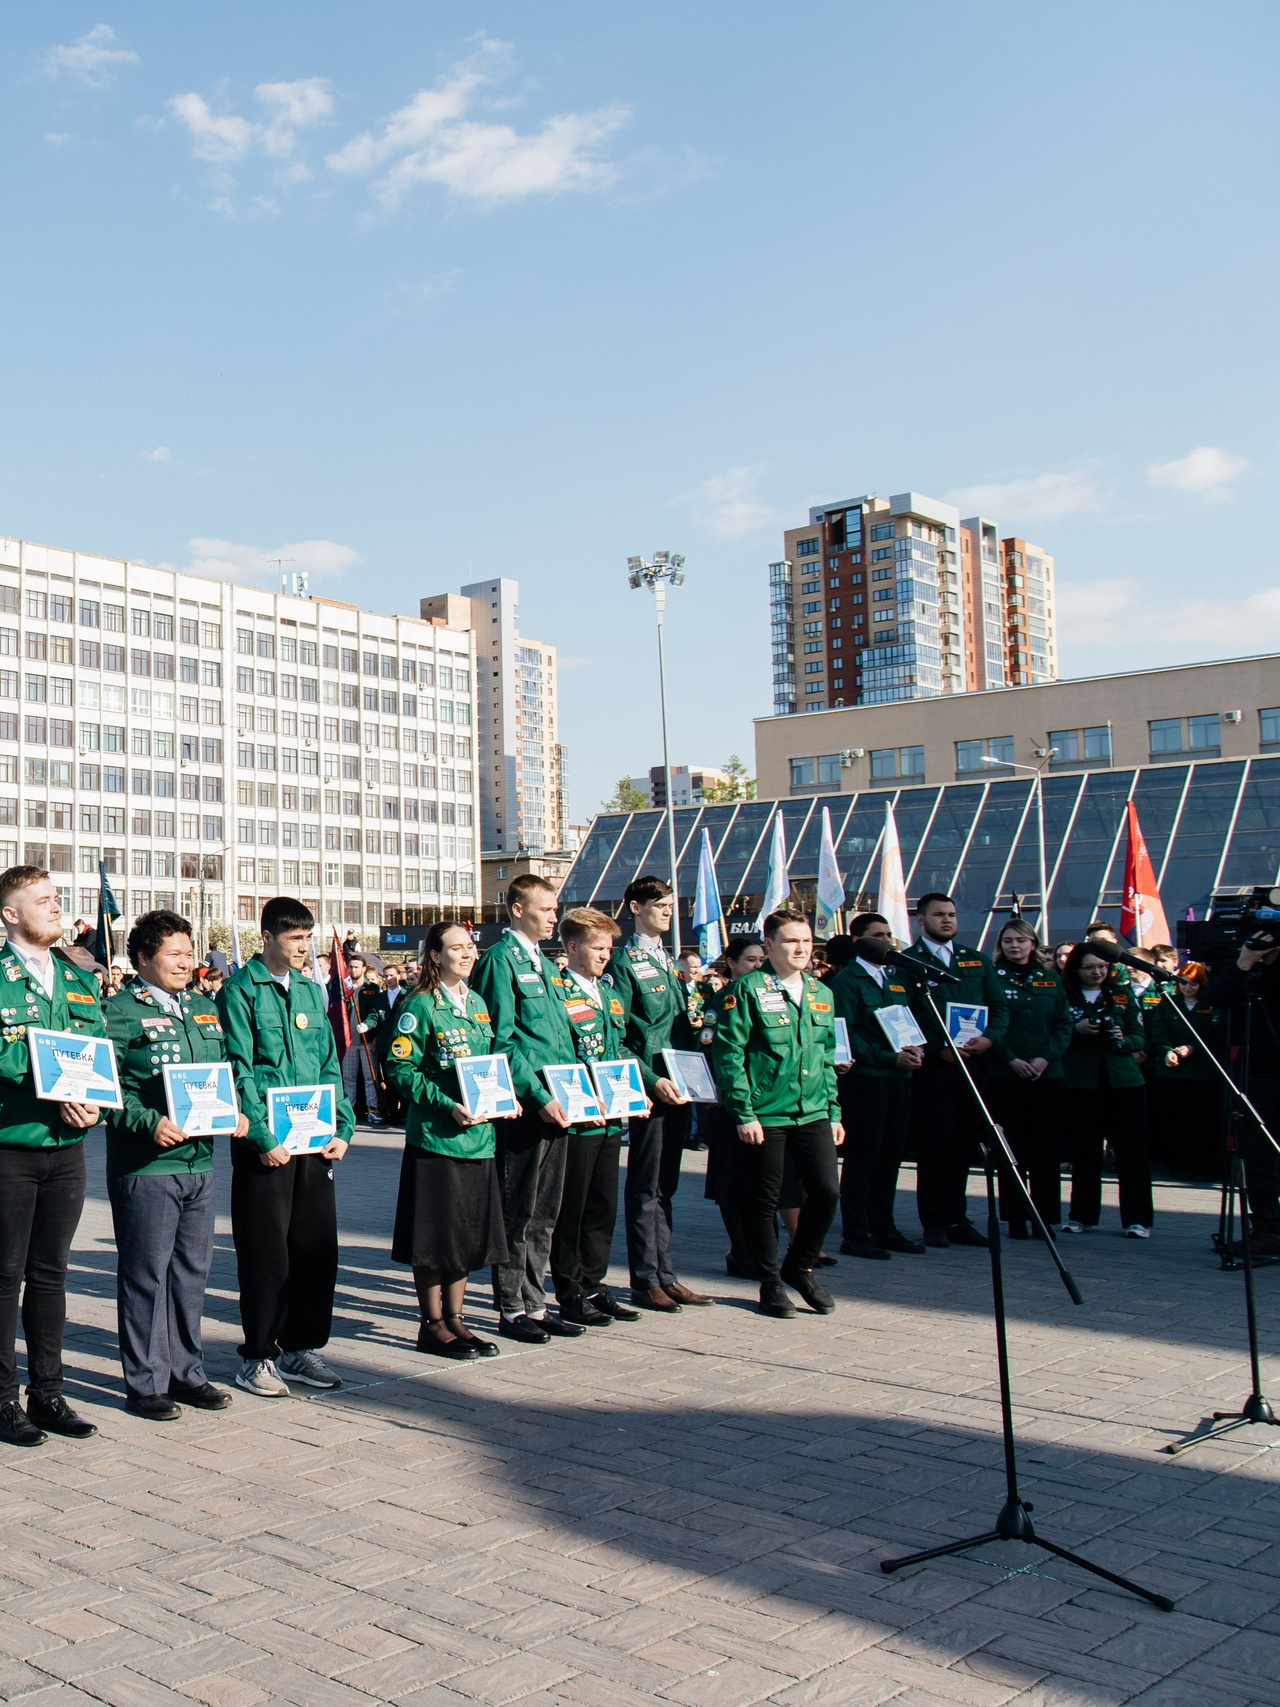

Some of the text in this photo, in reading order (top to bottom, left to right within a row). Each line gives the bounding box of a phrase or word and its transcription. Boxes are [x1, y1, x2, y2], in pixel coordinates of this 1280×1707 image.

[52, 1048, 95, 1062] ПУТЕВКА
[183, 1081, 217, 1090] ПУТЕВКА
[285, 1102, 319, 1112] ПУТЕВКА
